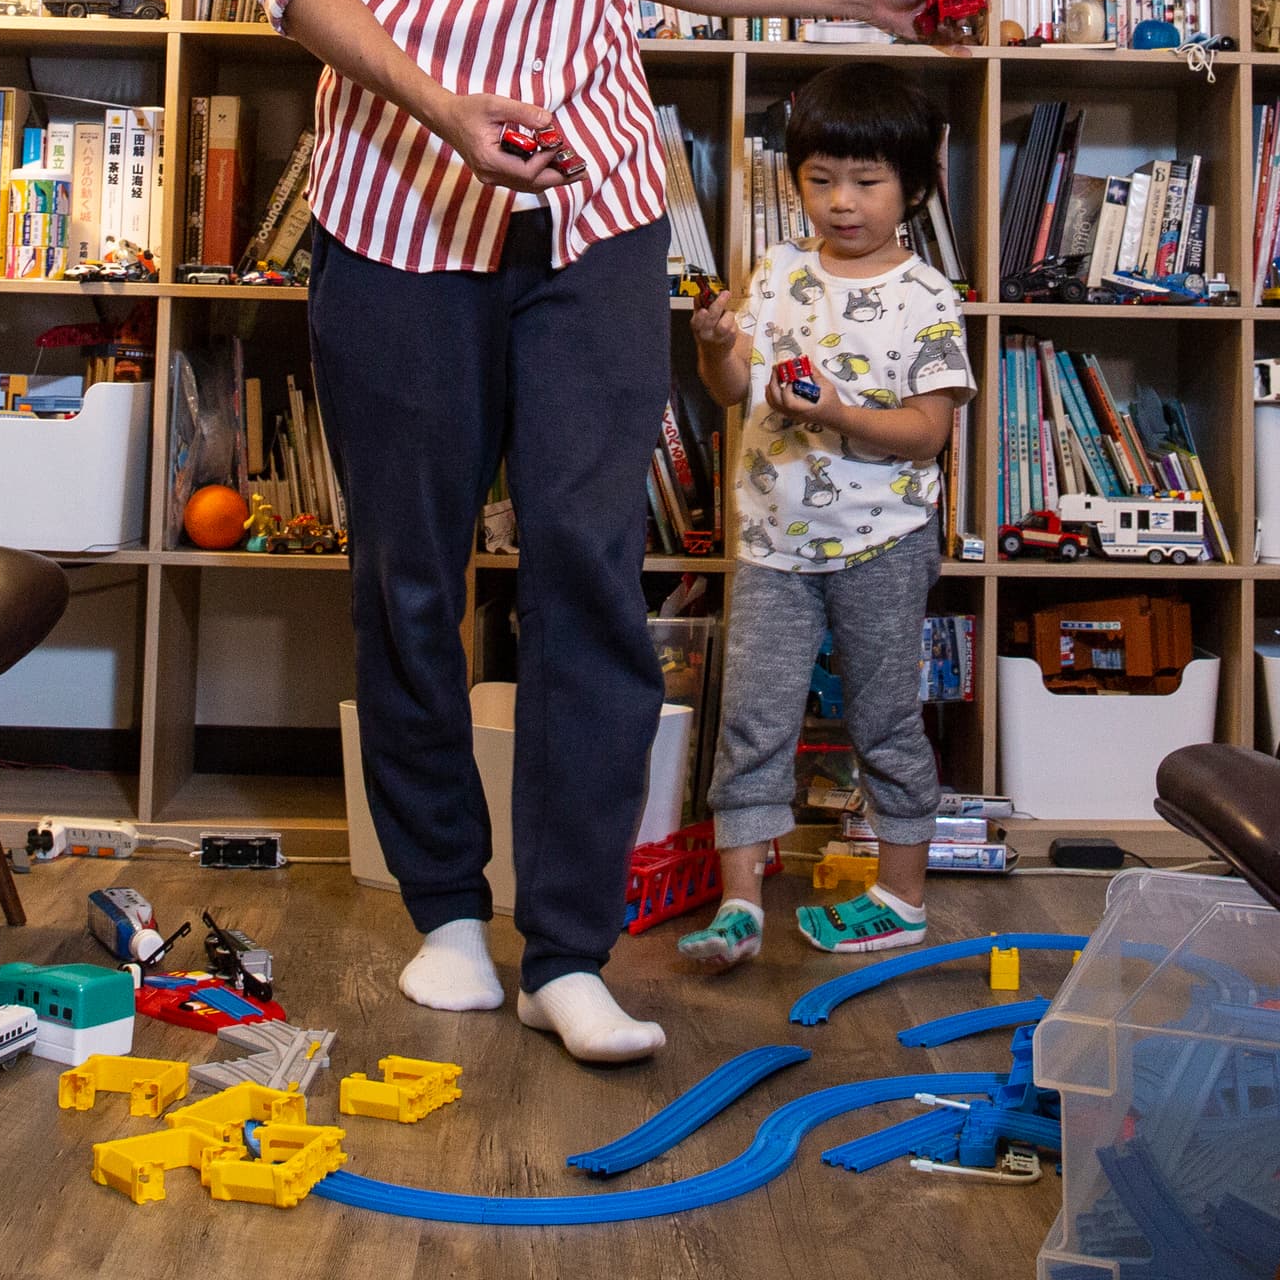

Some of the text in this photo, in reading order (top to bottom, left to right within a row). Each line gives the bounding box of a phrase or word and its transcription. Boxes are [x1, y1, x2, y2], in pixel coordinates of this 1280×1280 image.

[80, 147, 100, 223] ハウルの動く城
[107, 162, 120, 186] 茶经
[131, 163, 145, 200] 山海经
[1189, 237, 1204, 268] HOME
